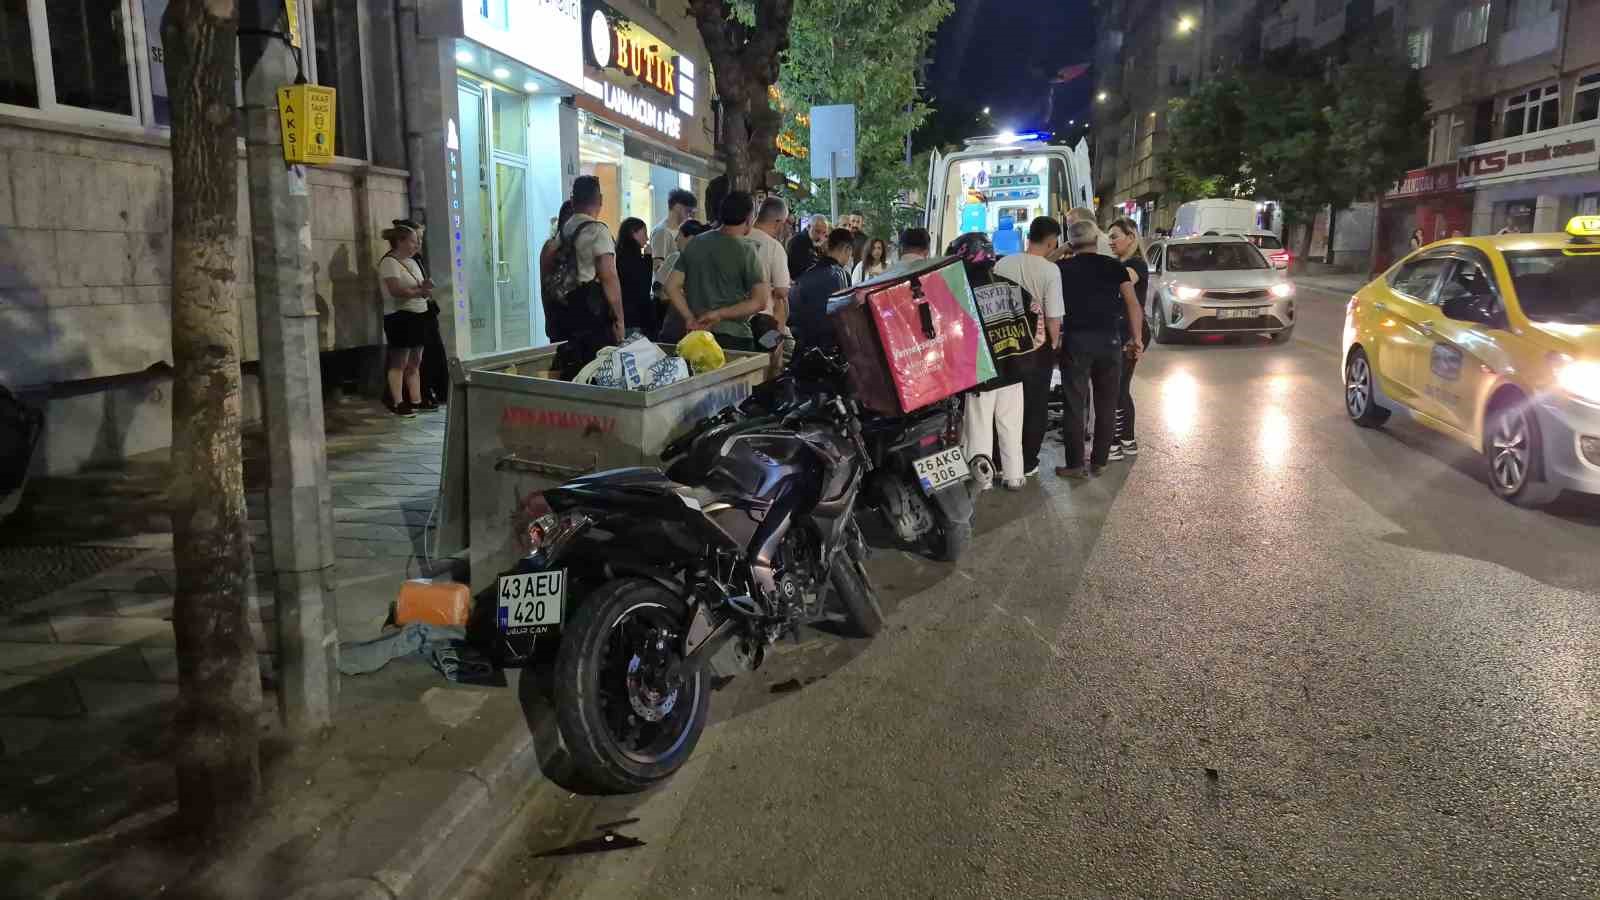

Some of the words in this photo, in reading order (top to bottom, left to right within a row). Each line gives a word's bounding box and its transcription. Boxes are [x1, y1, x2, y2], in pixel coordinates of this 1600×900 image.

[1457, 149, 1507, 177] NTS
[917, 459, 934, 474] 26
[935, 449, 961, 468] AKG
[931, 466, 956, 483] 306
[501, 578, 521, 599] 43
[523, 574, 561, 598] AEU
[514, 600, 545, 623] 420
